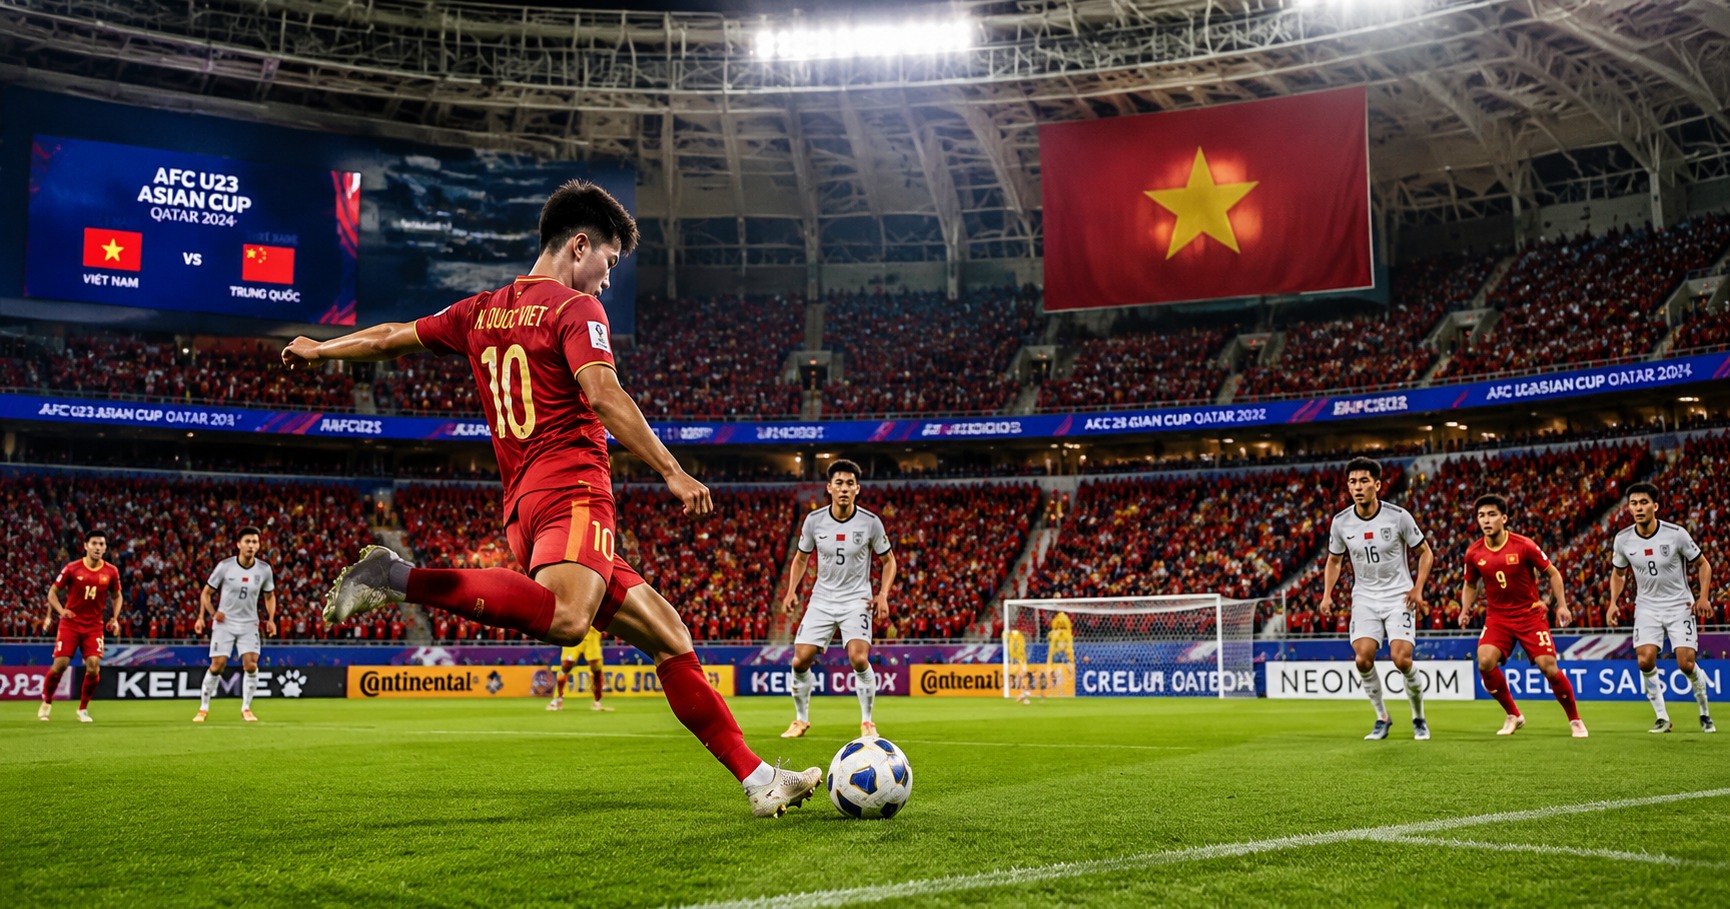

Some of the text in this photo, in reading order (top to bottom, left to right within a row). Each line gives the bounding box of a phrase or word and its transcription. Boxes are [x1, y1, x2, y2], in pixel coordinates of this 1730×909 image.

[153, 167, 238, 193] AFC U23
[137, 185, 251, 213] ASIAN CUP
[150, 207, 198, 223] QATAR
[201, 211, 234, 227] 2024
[183, 252, 202, 266] VS
[111, 276, 139, 288] NAM
[229, 286, 267, 300] TRUNG
[1575, 374, 1605, 390] CUP
[481, 344, 536, 440] 10
[135, 409, 163, 421] CUP
[1164, 413, 1191, 426] CUP
[592, 520, 615, 562] 10
[836, 547, 845, 566] 5
[1364, 546, 1380, 564] 16
[1648, 560, 1658, 576] 8
[1496, 570, 1507, 589] 9
[84, 585, 97, 600] 14
[1402, 612, 1412, 629] 3
